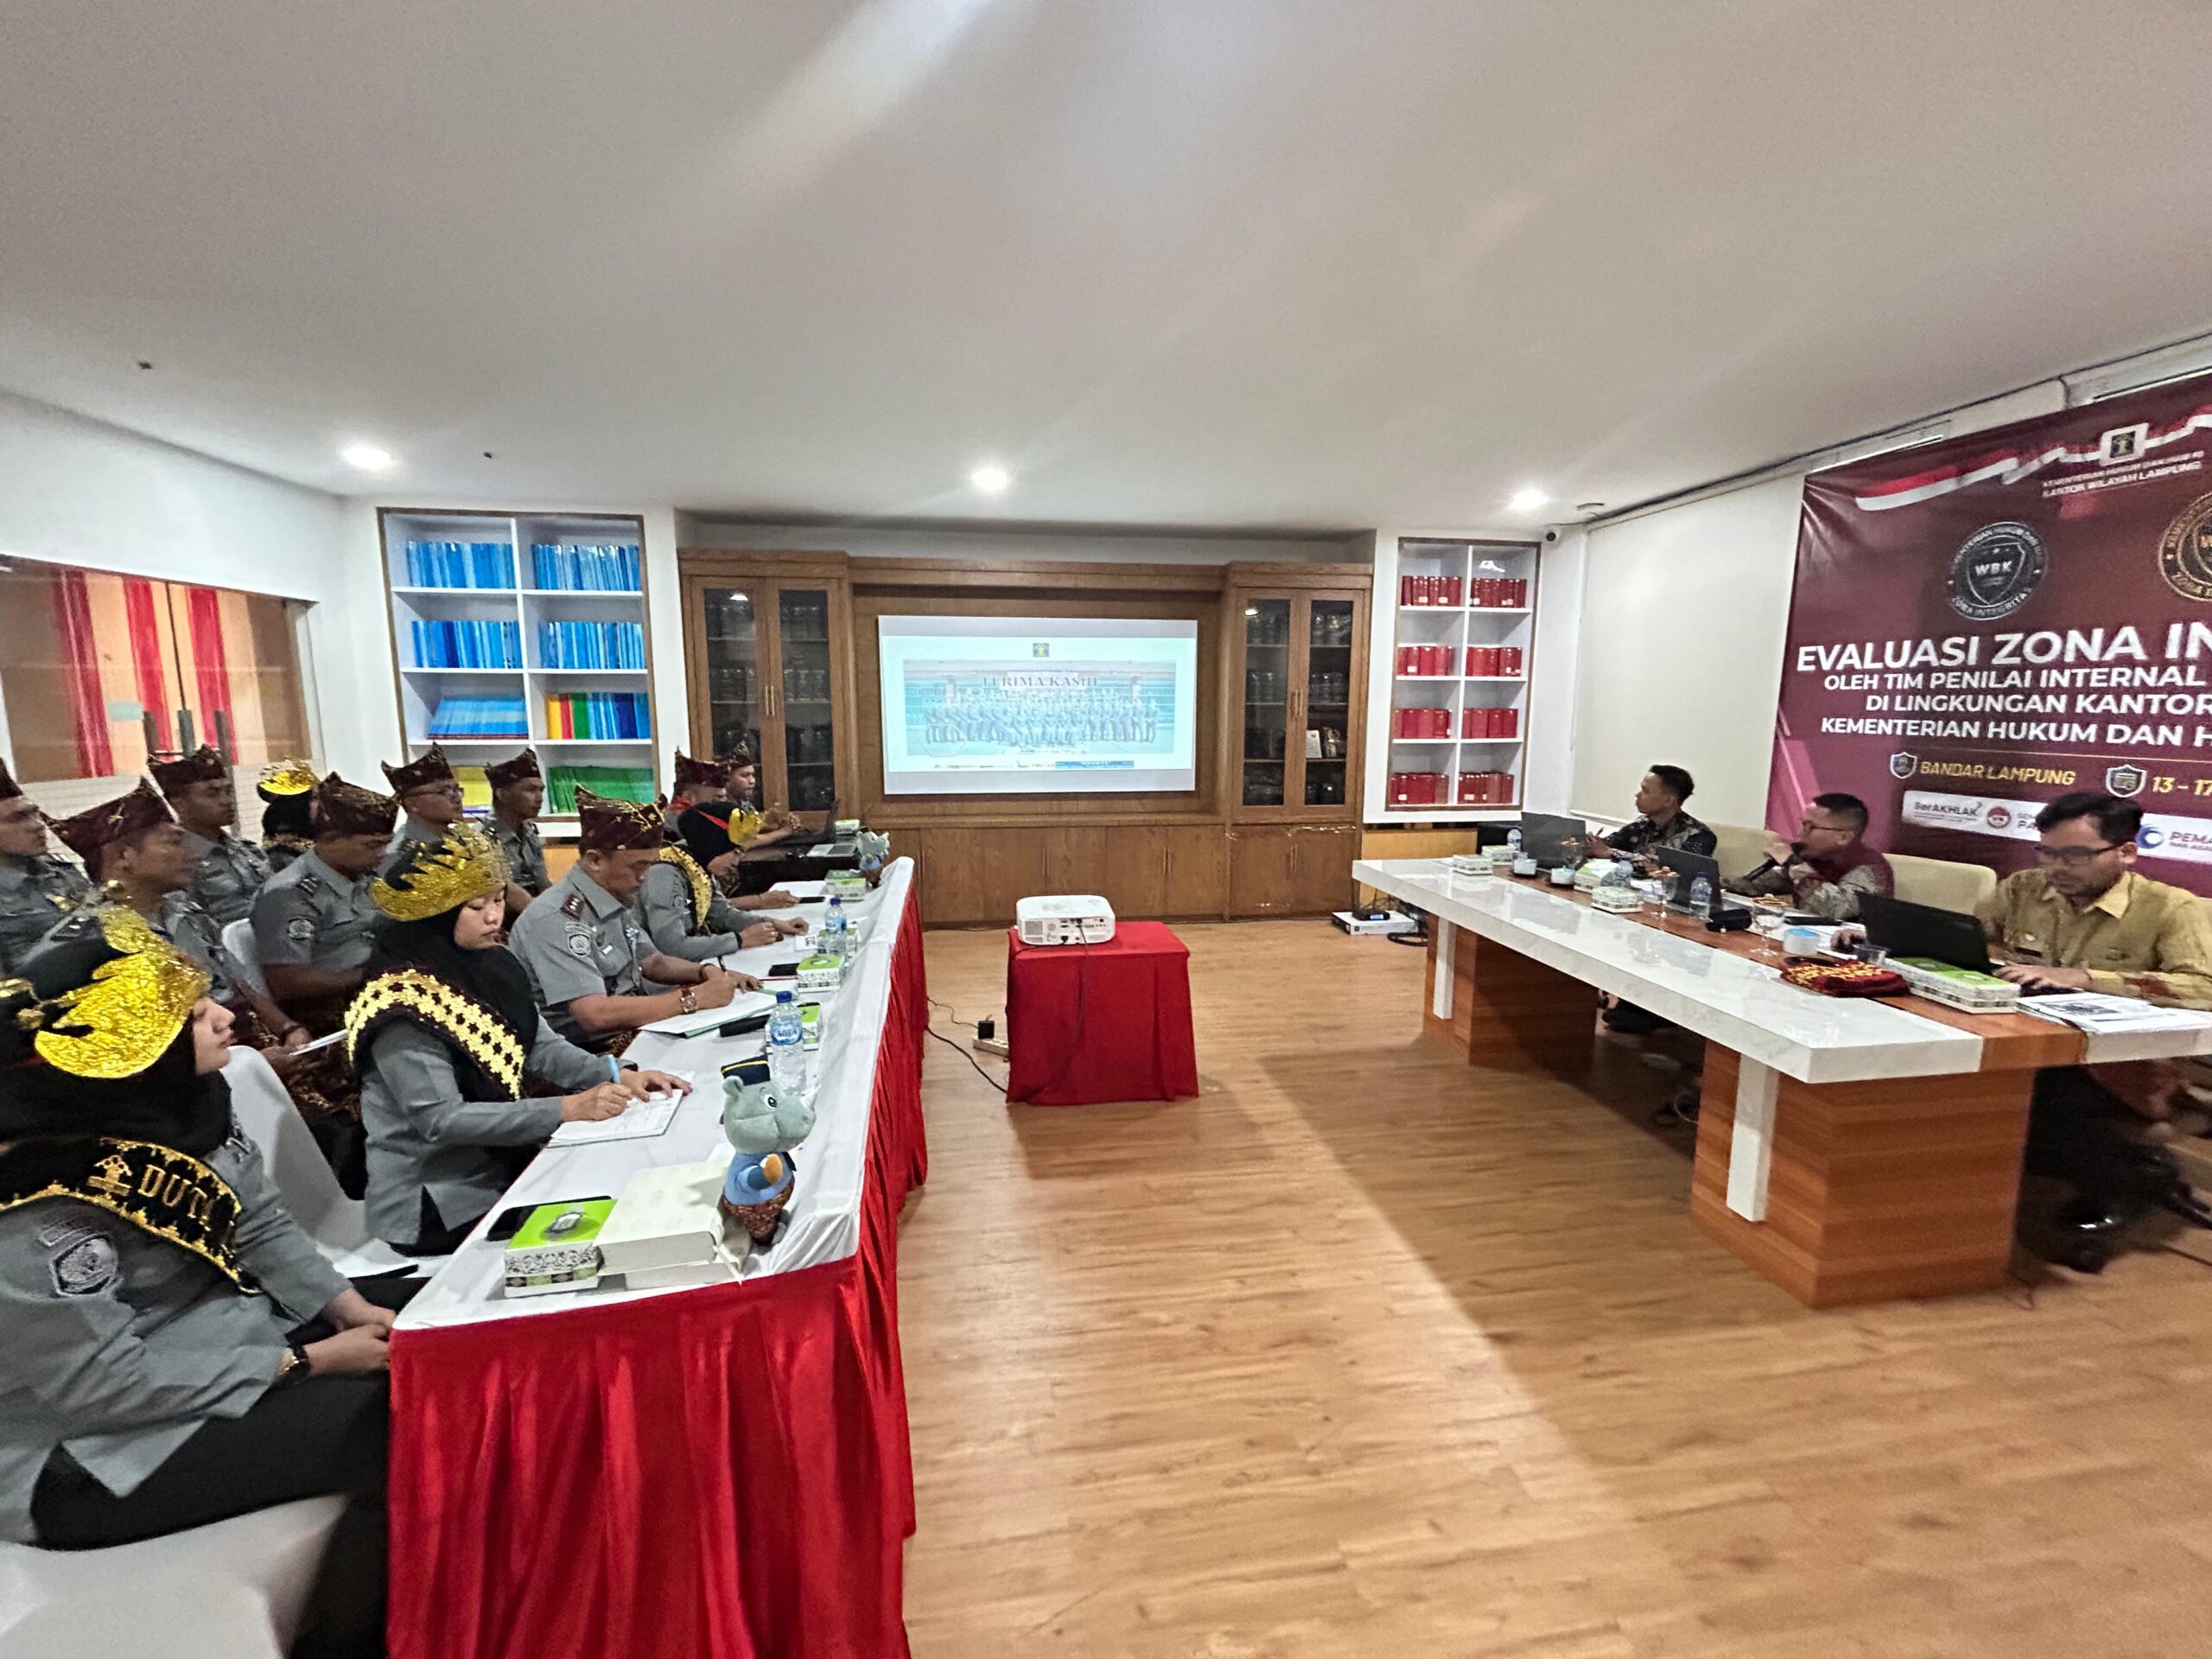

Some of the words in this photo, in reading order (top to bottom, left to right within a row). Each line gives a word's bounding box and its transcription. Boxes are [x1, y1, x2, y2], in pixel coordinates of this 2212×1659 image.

[2139, 461, 2202, 481] LAMPUNG
[1974, 560, 2012, 577] WBK
[1797, 636, 1980, 671] EVALUASI
[1992, 626, 2147, 664] ZONA
[1824, 674, 1878, 690] OLEH
[1884, 672, 1923, 690] TIM
[1929, 669, 2031, 689] PENILAI
[2040, 665, 2206, 688] INTERNAL
[1866, 695, 1889, 711] DI
[1894, 694, 2068, 713] LINGKUNGAN
[2075, 693, 2212, 715] KANTOR
[1821, 717, 1980, 738] KEMENTERIAN
[1987, 721, 2098, 743] HUKUM
[2106, 723, 2183, 747] DAN
[1920, 760, 1984, 779] BANDAR
[1986, 766, 2076, 785] LAMPUNG
[2152, 776, 2175, 793] 13
[2195, 779, 2212, 796] 17
